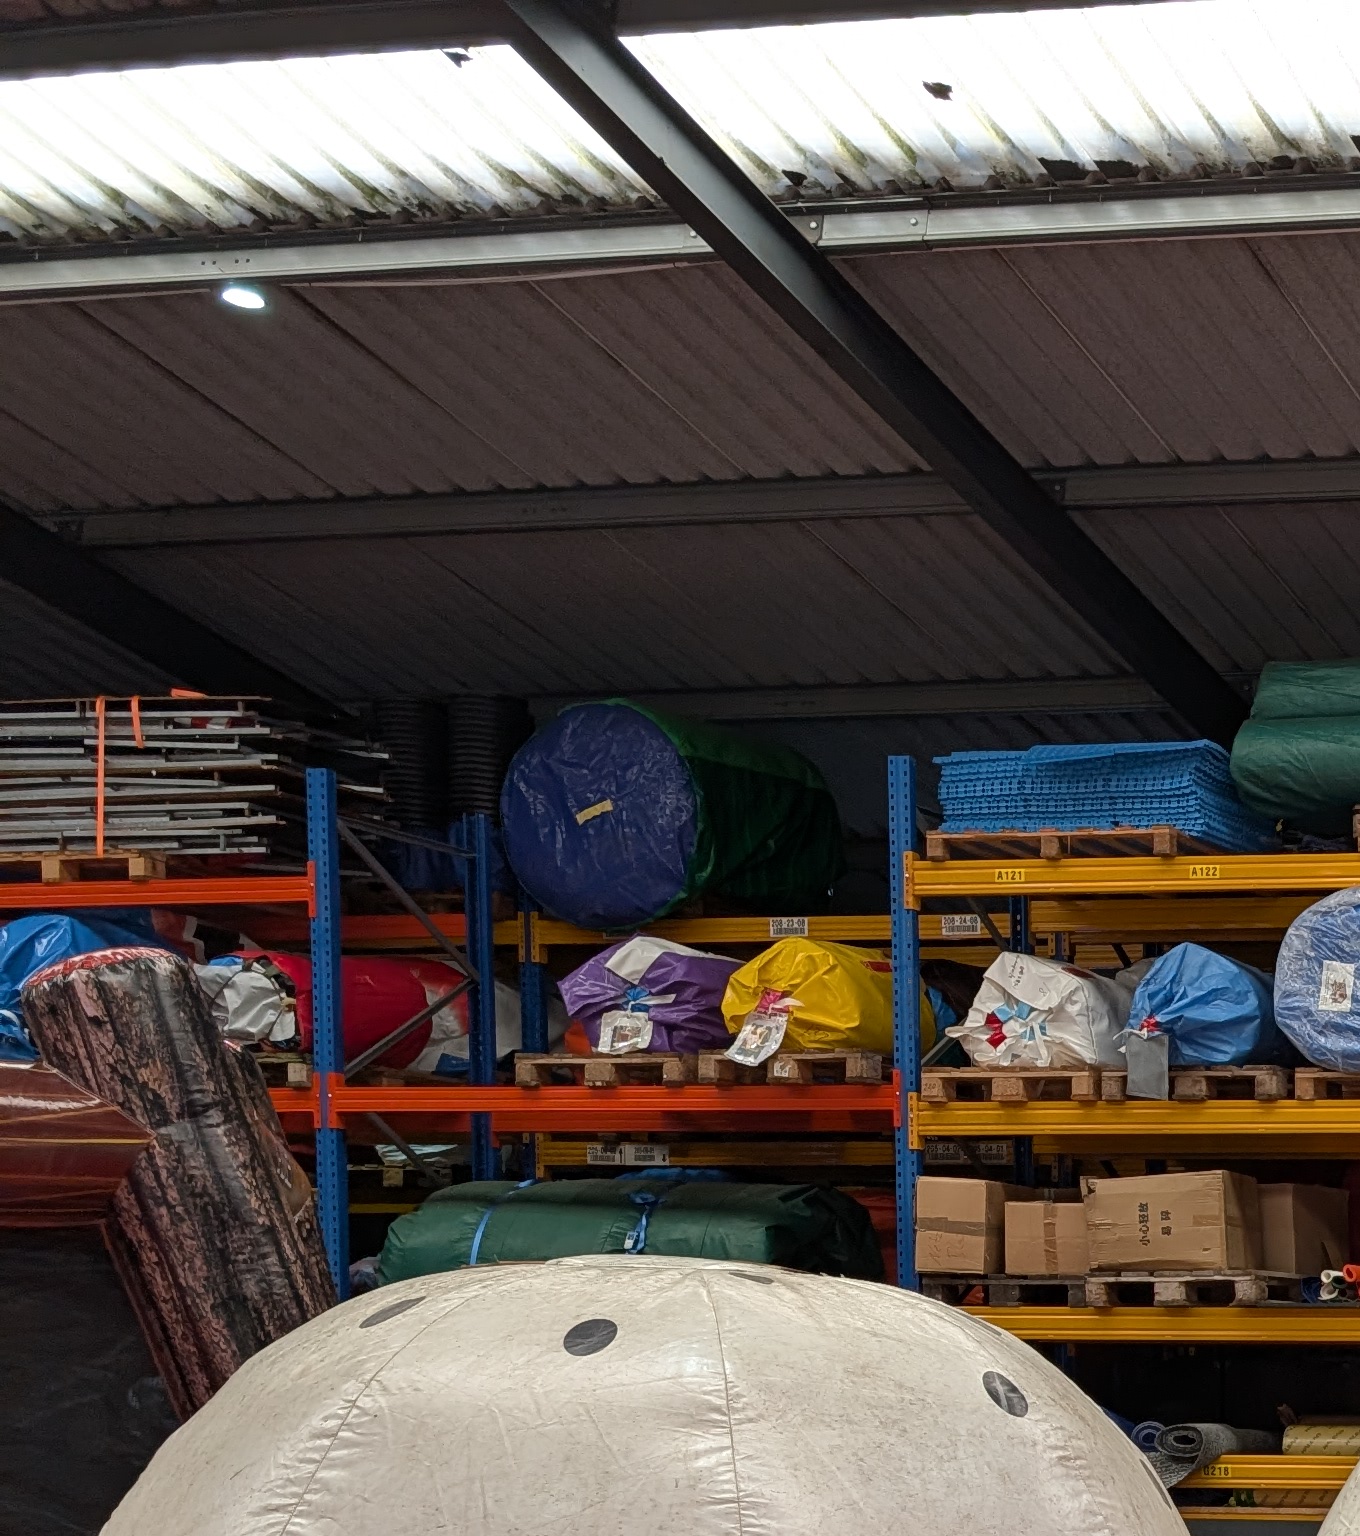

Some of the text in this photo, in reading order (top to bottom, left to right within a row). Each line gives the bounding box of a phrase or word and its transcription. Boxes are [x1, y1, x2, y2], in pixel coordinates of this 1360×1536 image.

[996, 870, 1022, 881] A121
[1191, 866, 1218, 877] A122
[1138, 1202, 1150, 1247] 小心轻放
